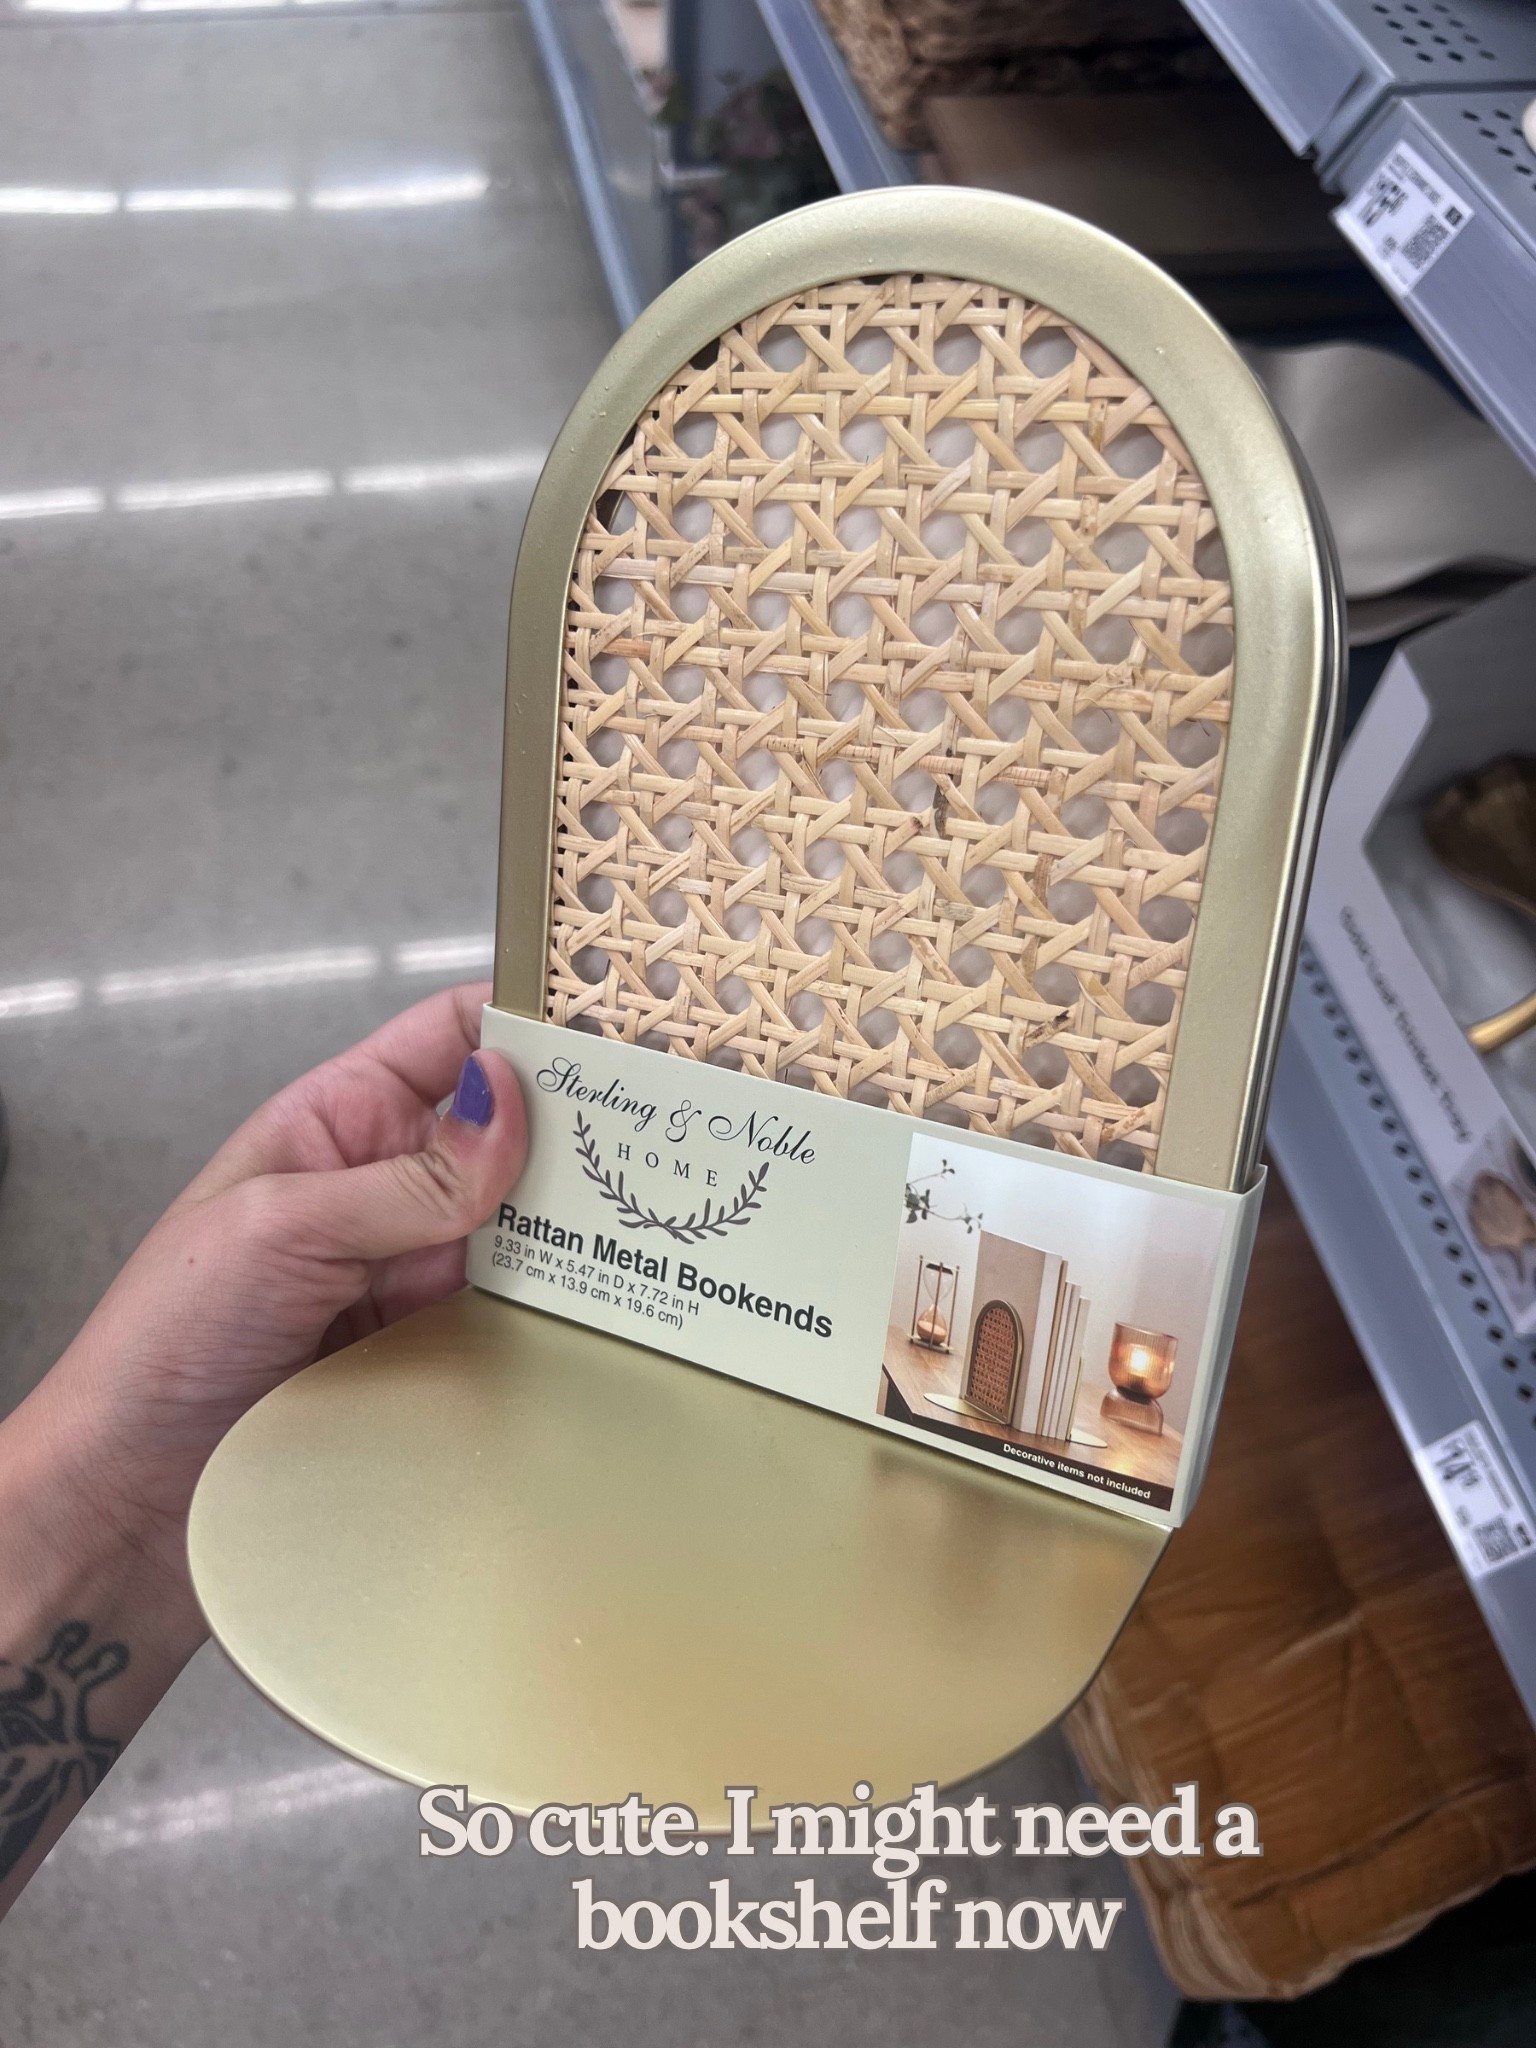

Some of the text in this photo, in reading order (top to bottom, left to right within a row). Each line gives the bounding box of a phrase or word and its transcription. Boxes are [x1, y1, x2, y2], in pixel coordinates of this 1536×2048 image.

[536, 1057, 816, 1165] Sterling & Noble
[492, 1251, 684, 1331] (23.7 cm x 13.9 cm x 19.6 cm)
[494, 1235, 700, 1316] 9.33 in W x 5.47 in D x 7.72 in H
[497, 1203, 833, 1338] Rattan Metal Bookends
[1003, 1443, 1151, 1499] Decorative items not included
